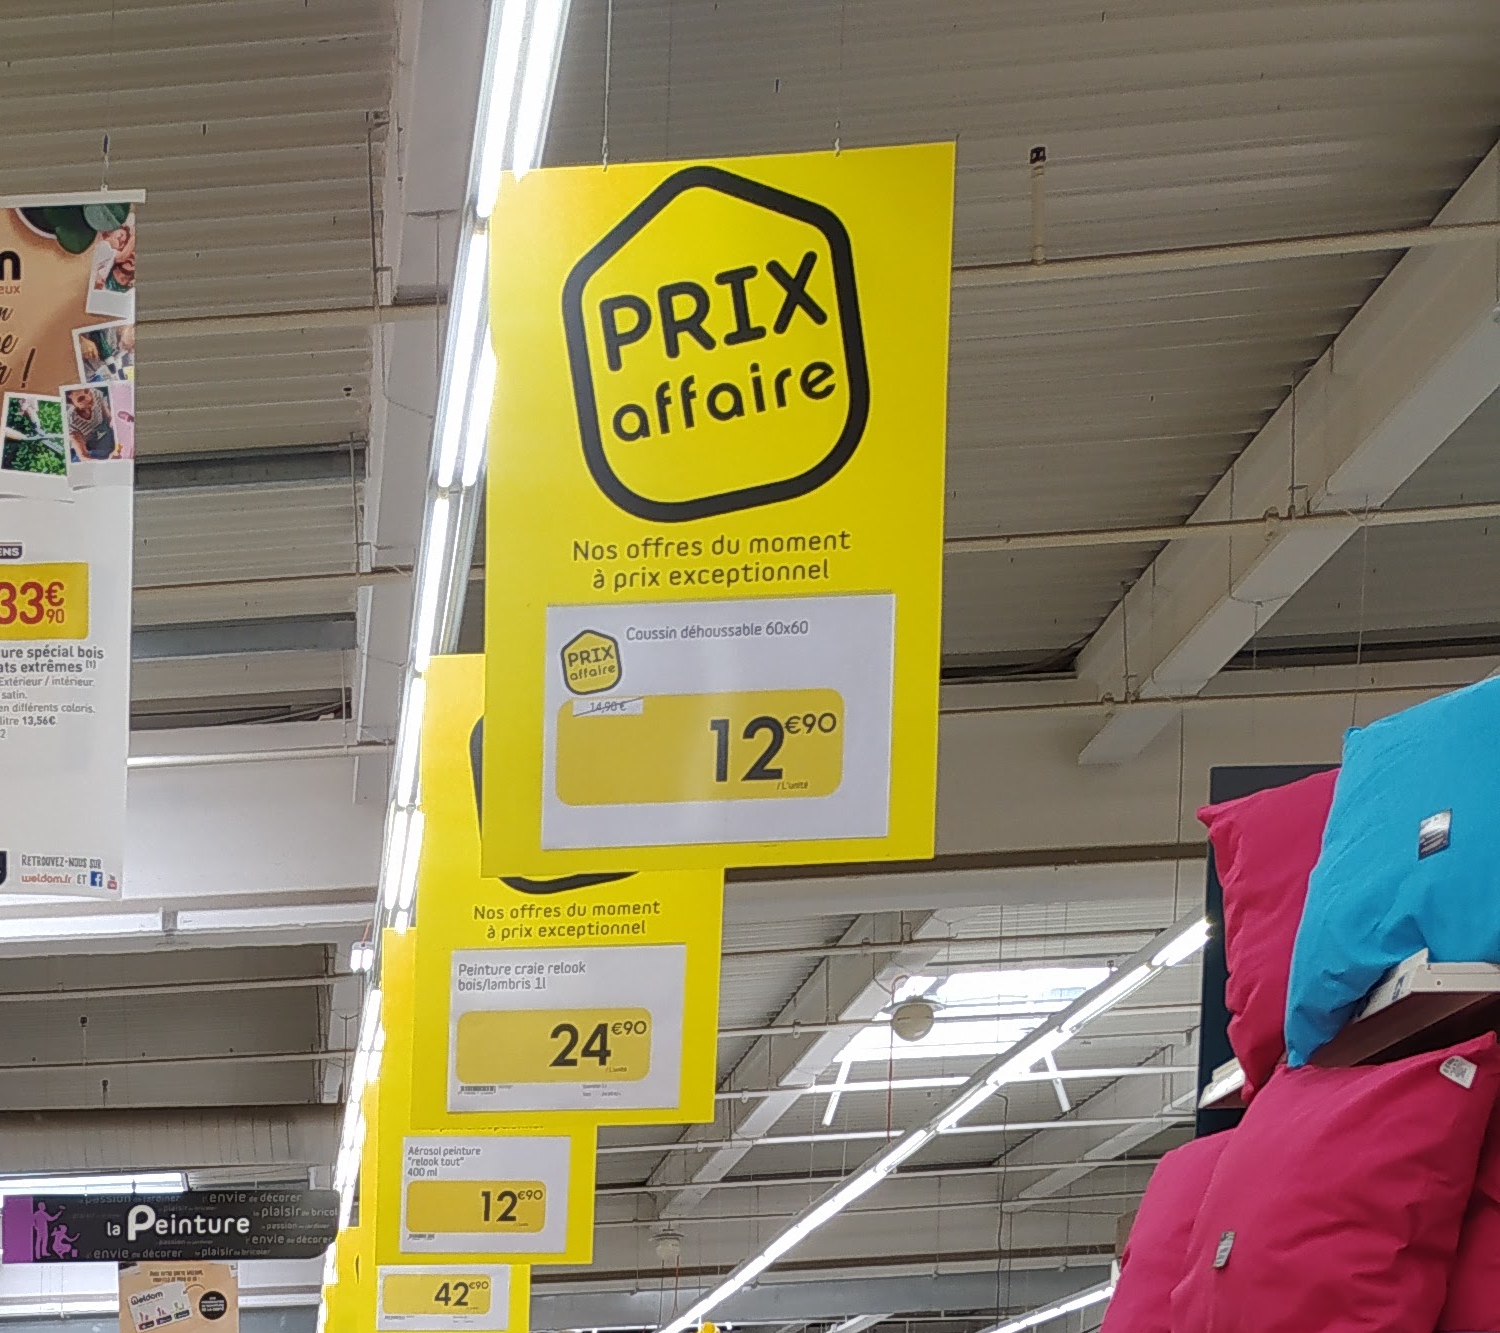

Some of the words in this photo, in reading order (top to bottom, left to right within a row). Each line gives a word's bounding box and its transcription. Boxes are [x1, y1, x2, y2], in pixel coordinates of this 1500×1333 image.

[599, 250, 828, 371] PRIX
[611, 360, 838, 442] affaire
[573, 539, 618, 562] Nos
[627, 534, 703, 561] offres
[712, 533, 740, 556] du
[749, 529, 851, 553] moment
[593, 568, 606, 589] à
[613, 566, 660, 593] prix
[668, 560, 830, 589] exceptionnel
[626, 625, 677, 642] Coussin
[680, 622, 762, 640] déhoussable
[764, 619, 809, 637] 60x60
[26, 644, 74, 663] spécial
[77, 646, 104, 659] bois
[567, 643, 615, 668] PRIX
[20, 659, 83, 673] extrêmes
[12, 702, 58, 713] différents
[0, 716, 19, 726] litre
[22, 715, 56, 727] 13,56€
[458, 962, 511, 977] Peinture
[514, 961, 545, 976] craie
[547, 960, 586, 975] relook
[457, 976, 532, 992] bois/lambris
[407, 1146, 442, 1156] Aérosol
[443, 1146, 481, 1157] peinture
[407, 1167, 426, 1177] 400
[427, 1167, 438, 1177] ml
[107, 1222, 121, 1236] la
[127, 1204, 250, 1241] Peinture
